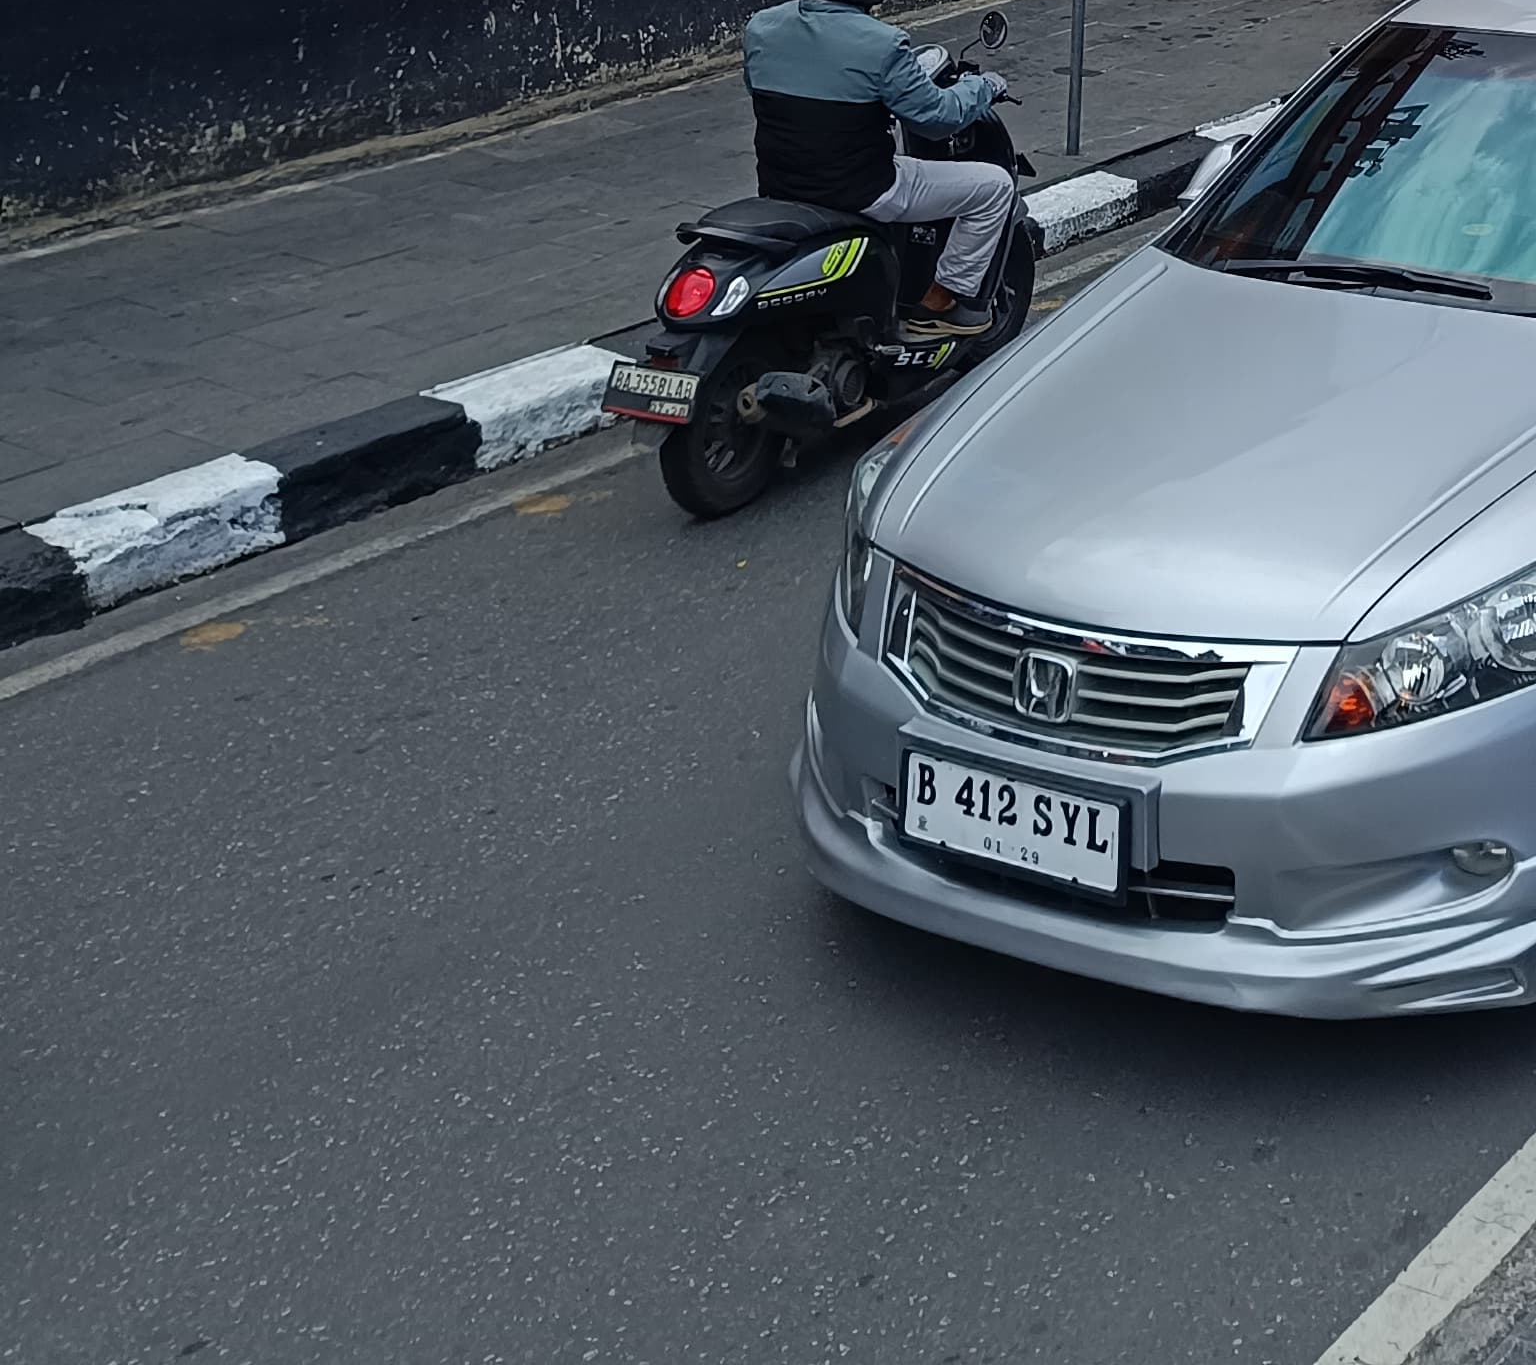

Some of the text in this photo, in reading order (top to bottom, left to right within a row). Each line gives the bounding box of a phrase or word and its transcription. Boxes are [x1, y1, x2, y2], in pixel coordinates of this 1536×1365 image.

[917, 762, 1109, 855] B 412 SYL
[983, 835, 1040, 866] 01 29
